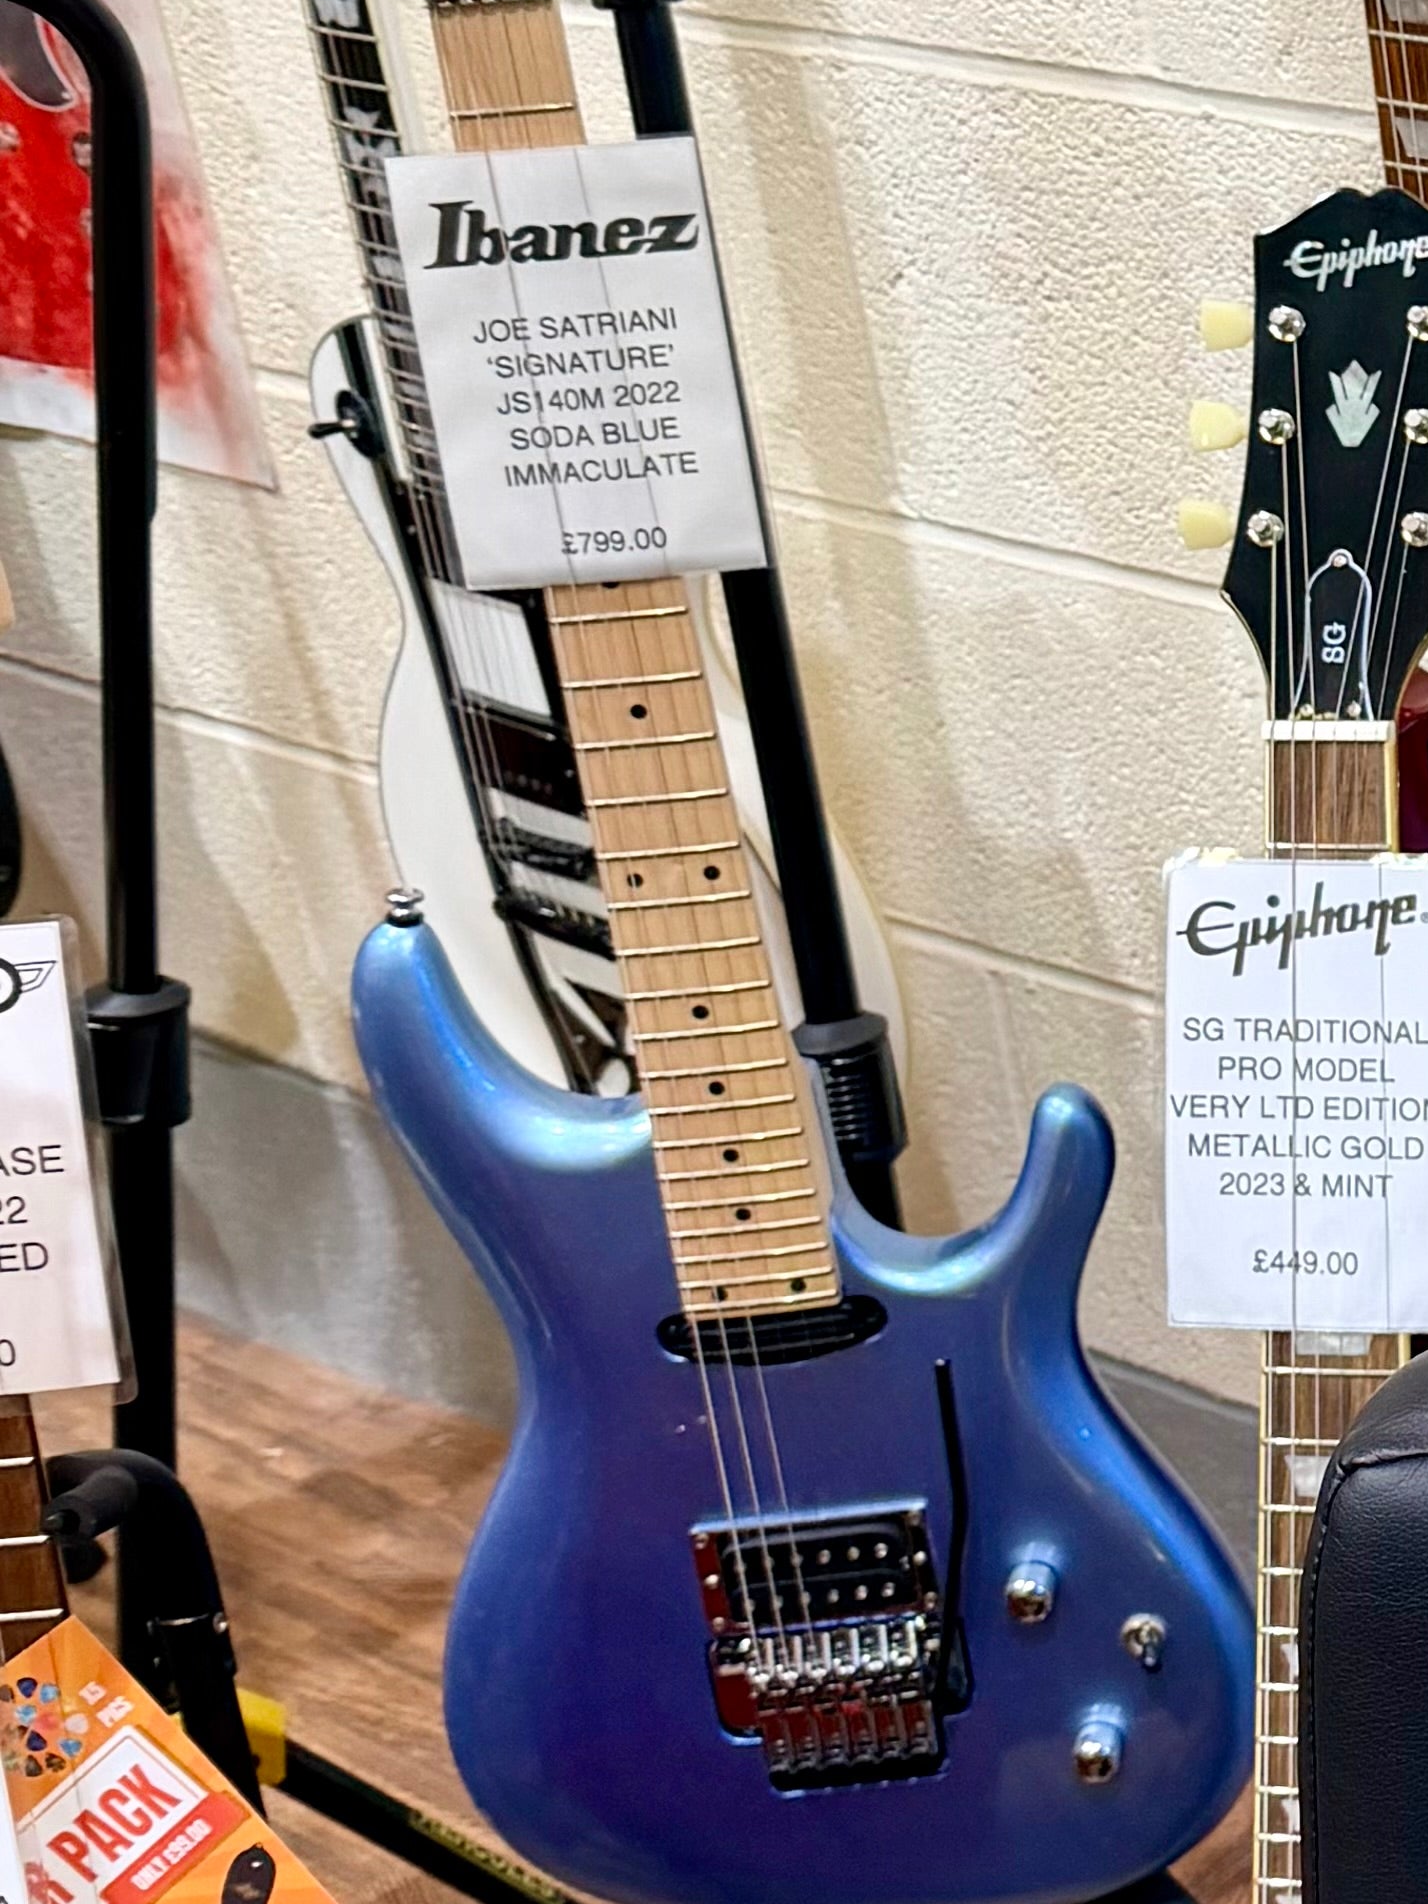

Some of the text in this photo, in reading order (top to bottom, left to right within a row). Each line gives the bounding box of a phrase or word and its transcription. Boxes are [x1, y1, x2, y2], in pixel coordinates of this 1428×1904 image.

[423, 199, 699, 270] Ibanez
[473, 307, 678, 344] JOE SATRIANI
[497, 380, 682, 415] JS140M 2022
[509, 416, 682, 451] SODA BLUE
[504, 451, 700, 488] IMMACULATE
[561, 526, 668, 556] £799.00
[1321, 621, 1347, 664] SG
[1175, 881, 1419, 977] Epiphone
[1182, 1016, 1225, 1043] SG
[1217, 1056, 1396, 1085] PRO MODEL
[1170, 1094, 1251, 1120] VERY
[1259, 1095, 1315, 1121] LTD
[1187, 1133, 1426, 1161] METALLIC GOLD
[1219, 1172, 1394, 1199] 2023 & MINT
[1252, 1248, 1359, 1278] £449.00
[47, 1764, 183, 1884] PACK
[130, 1854, 173, 1892] ONLY
